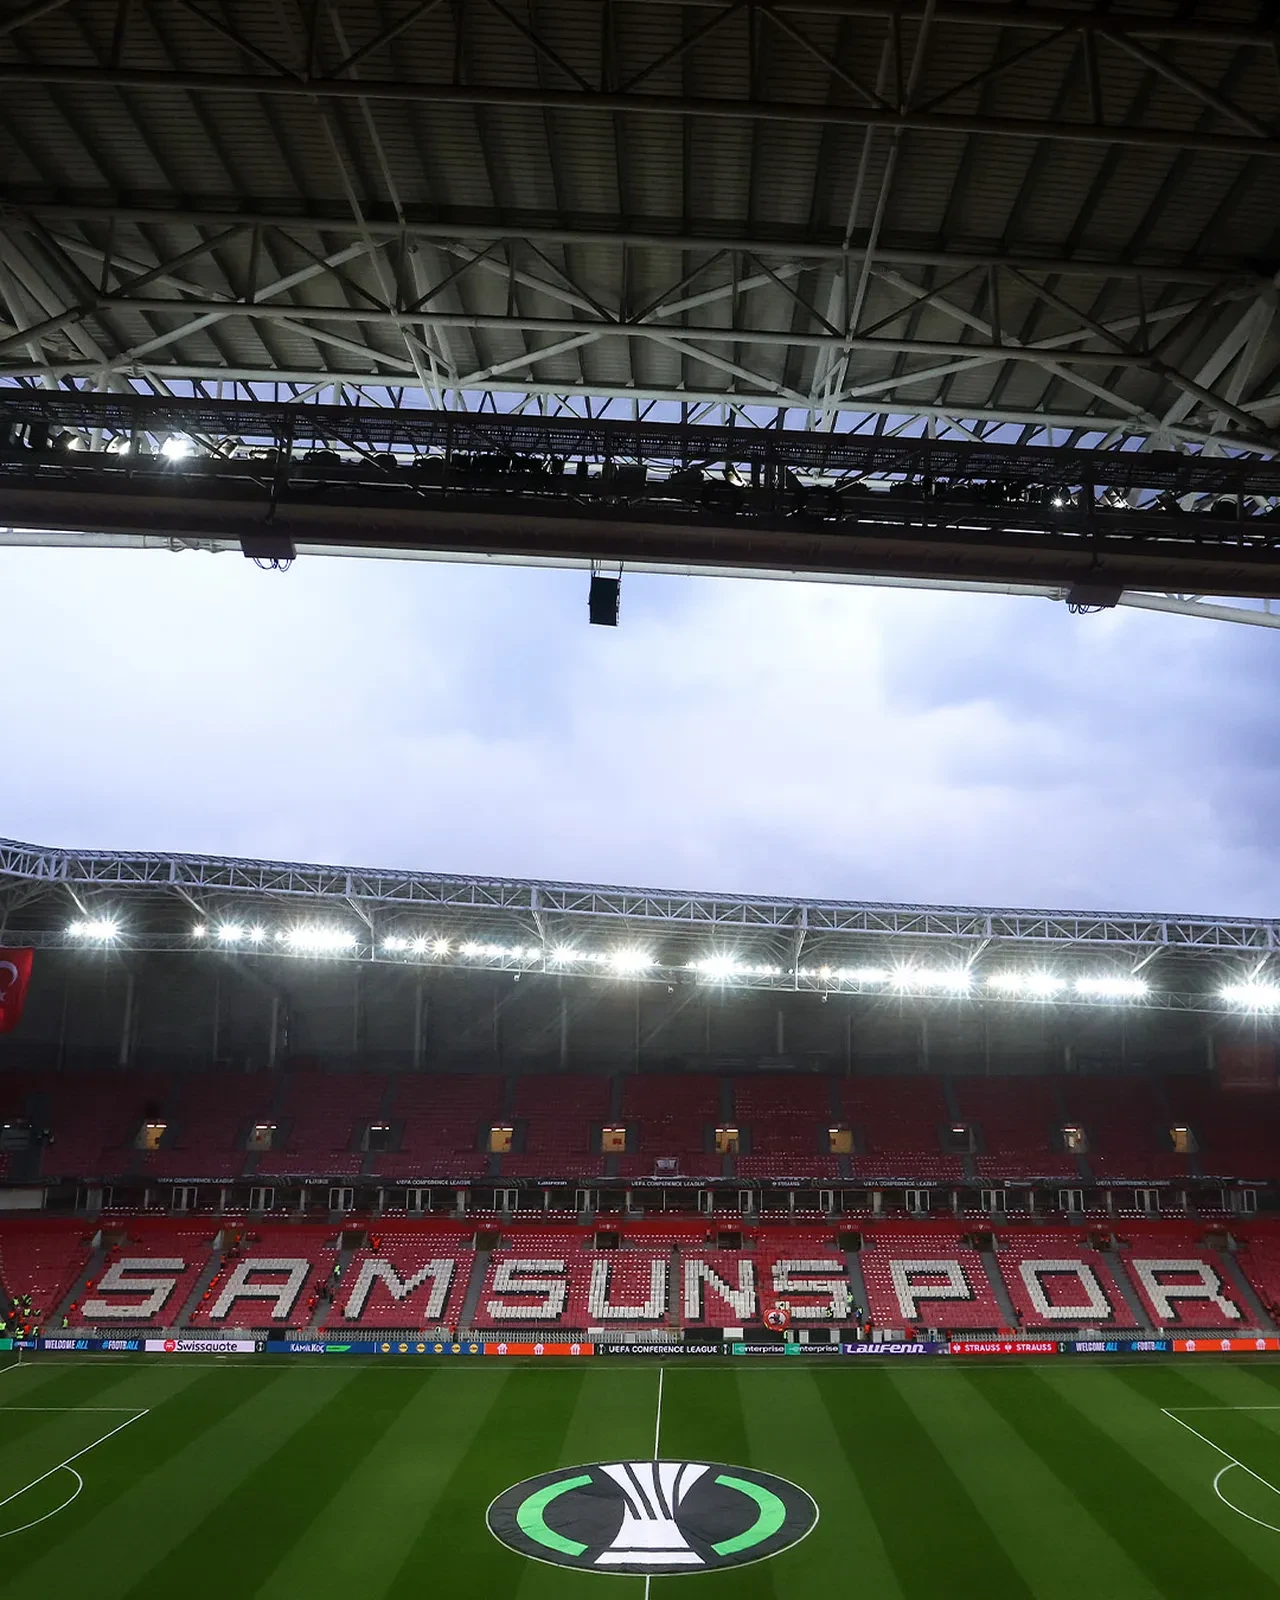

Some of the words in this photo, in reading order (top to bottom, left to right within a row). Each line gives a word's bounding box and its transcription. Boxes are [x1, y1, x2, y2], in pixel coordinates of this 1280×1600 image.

[80, 1257, 1242, 1321] SAMSUNSPOR
[44, 1339, 76, 1350] WELCOME
[75, 1339, 89, 1350] ALL
[101, 1339, 139, 1350] #FOOTBALL
[176, 1340, 238, 1352] Swissquote
[608, 1345, 631, 1353] UEFA
[632, 1345, 685, 1354] CONFERENCE
[686, 1345, 718, 1354] LEAGUE
[736, 1345, 785, 1354] enterprise
[788, 1345, 839, 1354] enterprise
[964, 1343, 1001, 1352] STRAUSS
[1016, 1343, 1052, 1352] STRAUSS
[1075, 1342, 1106, 1352] WELCOME
[1105, 1342, 1118, 1351] ALL
[1130, 1341, 1167, 1351] #FOOTBALL
